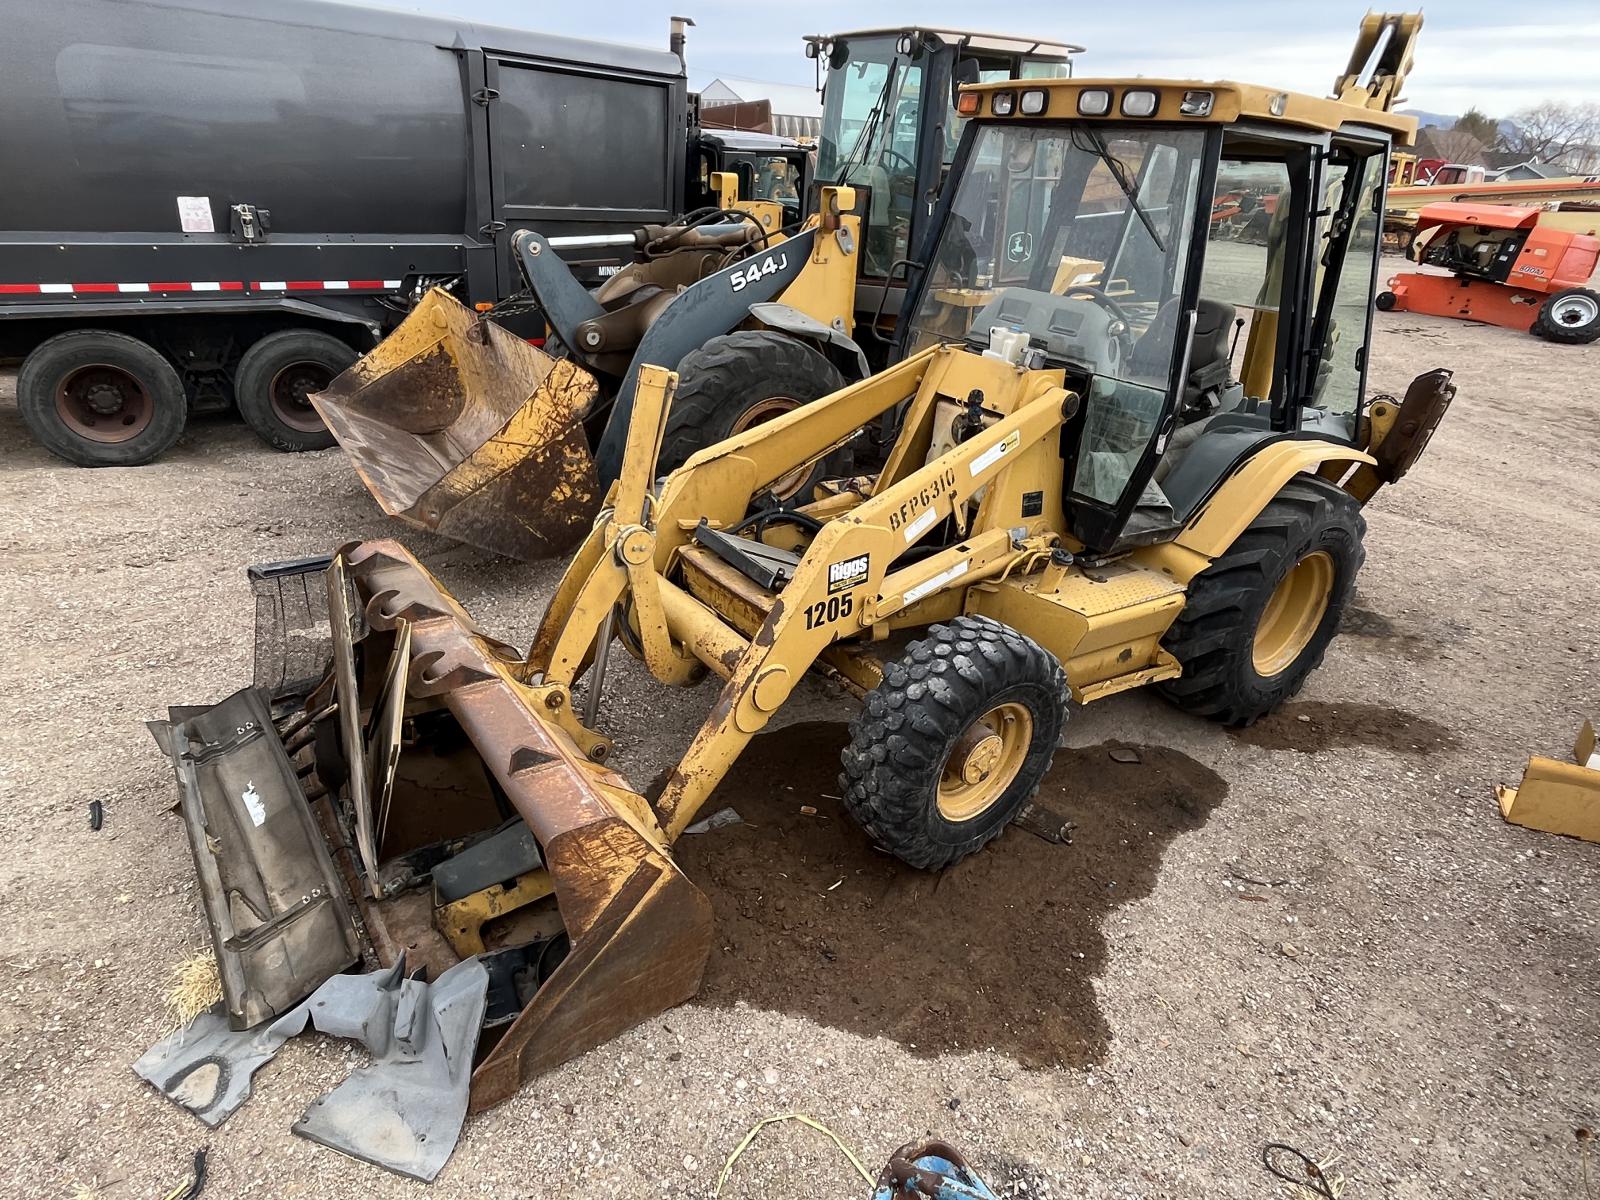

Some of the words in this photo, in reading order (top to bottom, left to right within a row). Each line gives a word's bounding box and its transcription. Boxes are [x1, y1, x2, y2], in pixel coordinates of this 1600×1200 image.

[730, 253, 788, 292] 544J
[830, 557, 868, 583] Riggs
[804, 591, 853, 631] 1205
